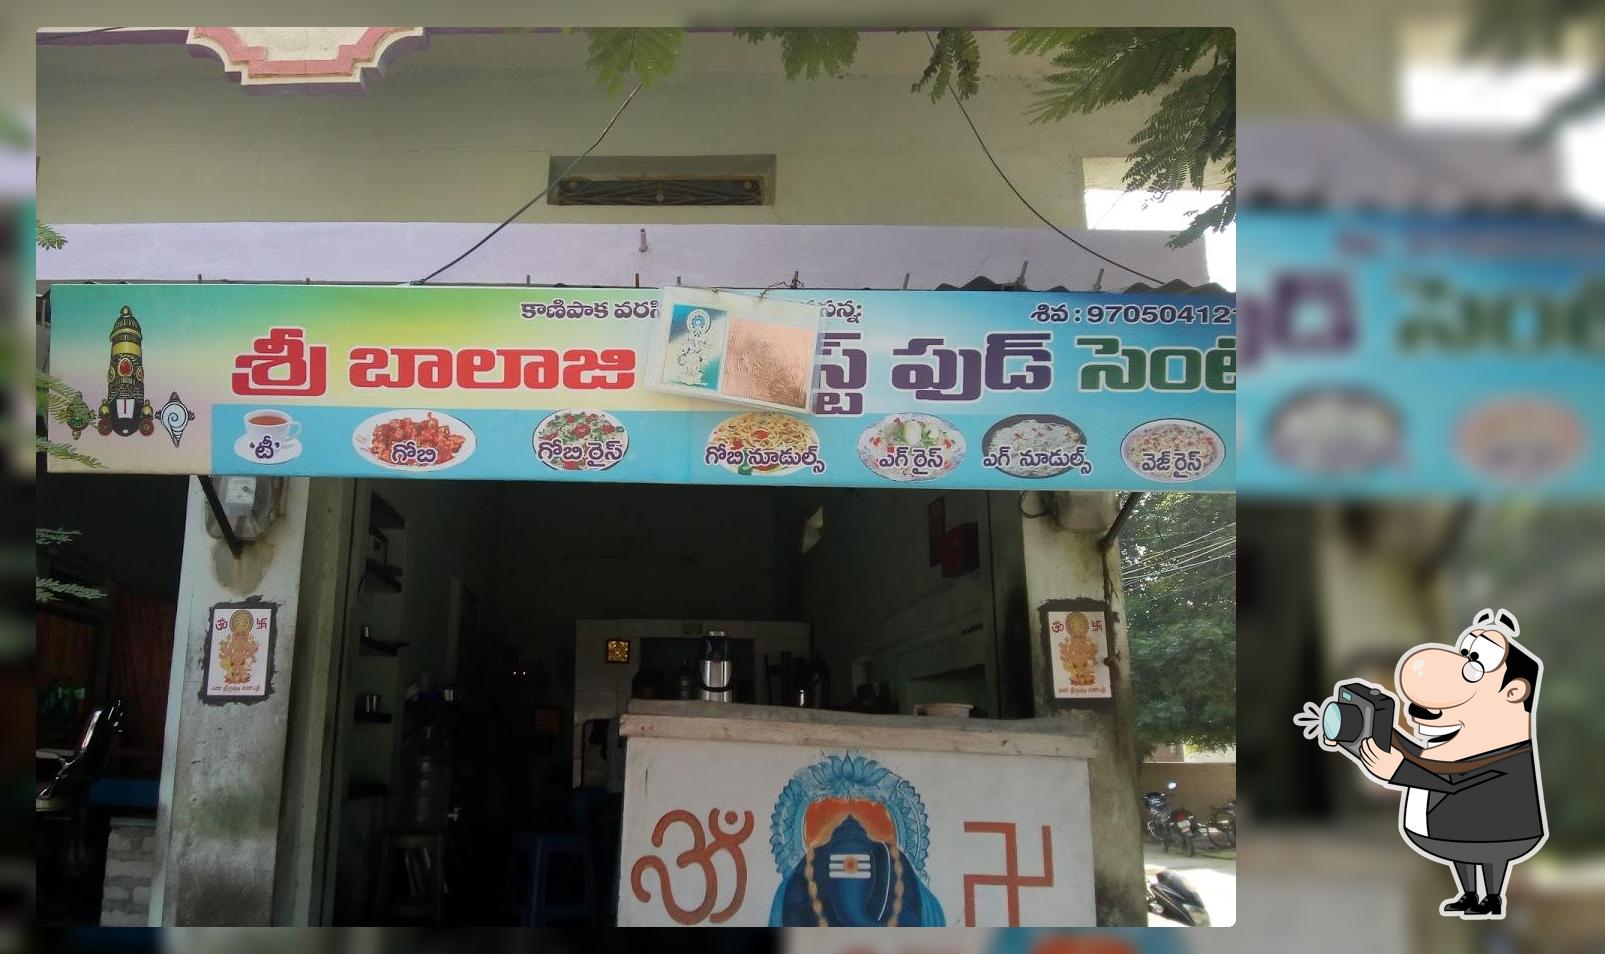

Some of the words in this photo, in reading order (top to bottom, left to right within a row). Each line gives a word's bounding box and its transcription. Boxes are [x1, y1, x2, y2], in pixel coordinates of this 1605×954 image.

[520, 299, 609, 319] కాణిపాక
[1087, 305, 1236, 323] 97050412
[231, 328, 327, 396] శ్రీ
[349, 347, 636, 390] బాలాజి
[391, 441, 438, 464] గోబి
[538, 439, 582, 460] గోబి
[705, 446, 743, 465] గోబి
